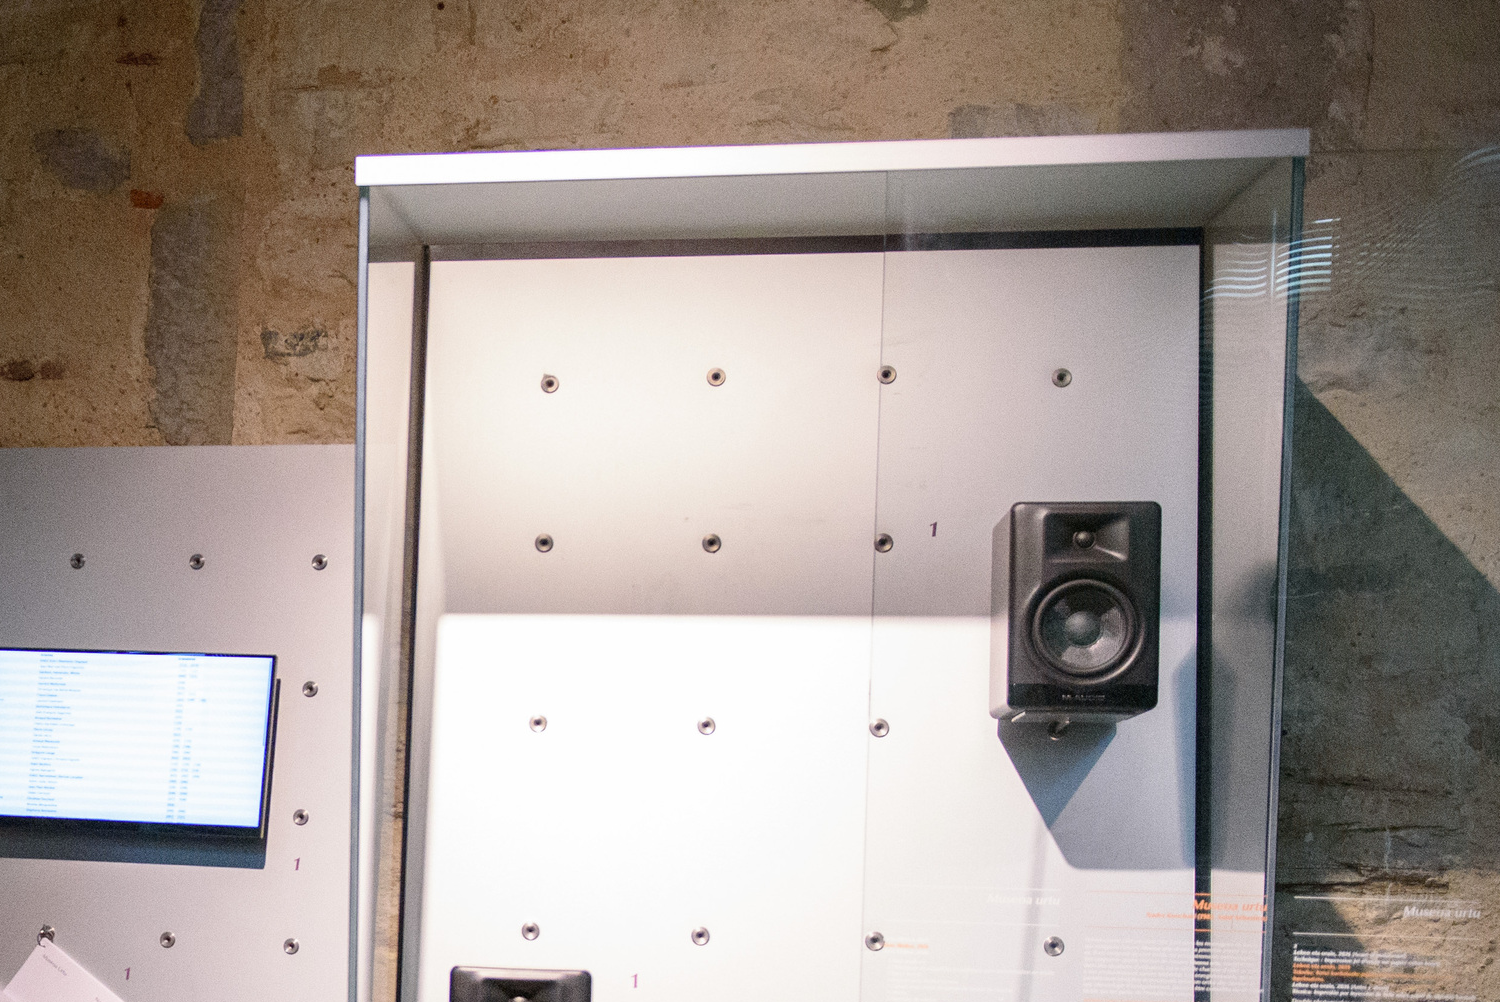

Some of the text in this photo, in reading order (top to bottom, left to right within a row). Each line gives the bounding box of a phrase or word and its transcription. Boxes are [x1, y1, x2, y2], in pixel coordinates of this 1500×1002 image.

[928, 521, 938, 537] 1
[293, 856, 301, 871] 1
[123, 967, 131, 981] 1
[630, 973, 639, 988] 1
